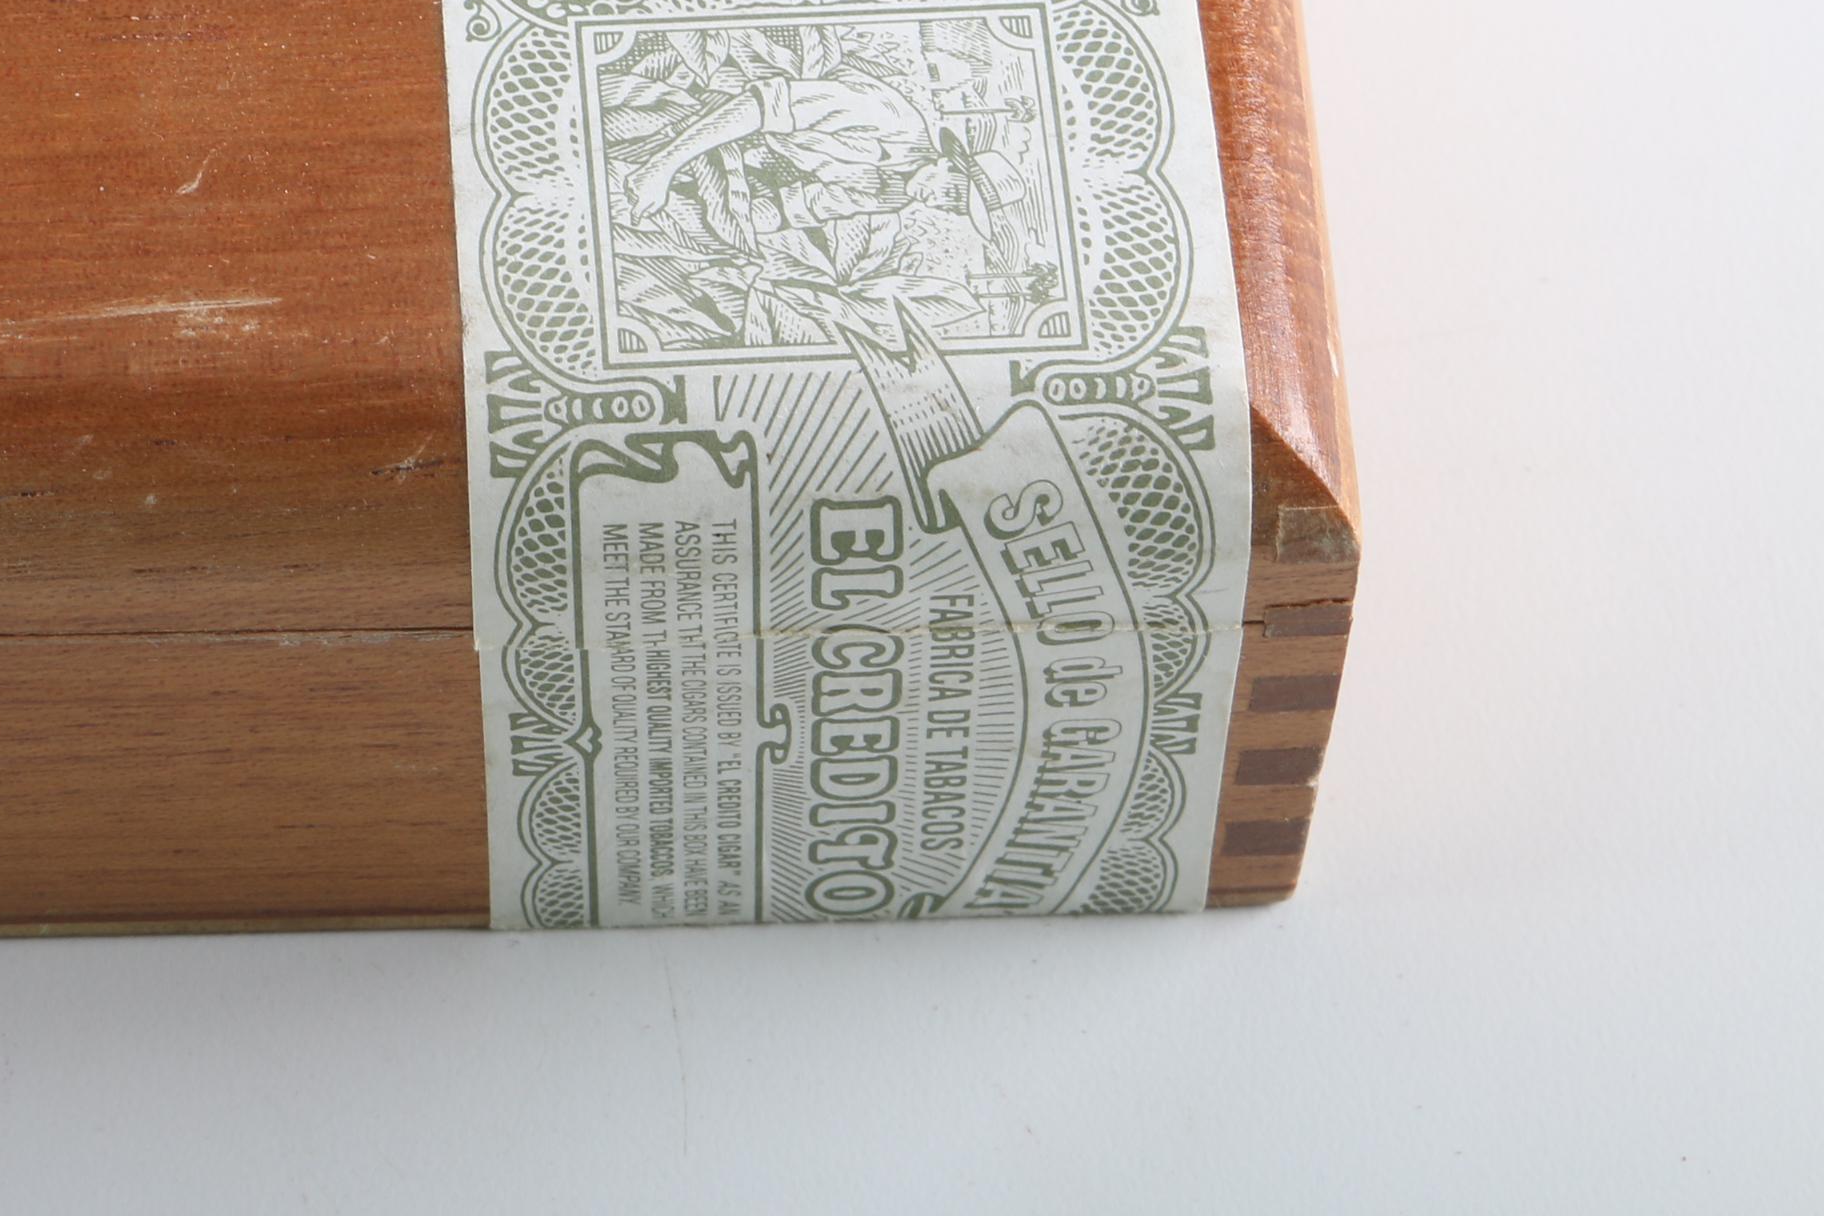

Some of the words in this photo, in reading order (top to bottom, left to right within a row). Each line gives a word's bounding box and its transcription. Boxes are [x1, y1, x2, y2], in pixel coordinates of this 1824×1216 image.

[603, 524, 630, 572] MEET
[639, 522, 666, 574] MADE
[712, 519, 738, 565] THIS
[810, 495, 904, 611] EL
[984, 480, 1115, 646] SELLO
[605, 577, 630, 607] THE
[675, 520, 703, 621] ASSURANCE
[640, 580, 667, 624] FROM
[680, 653, 706, 676] THE
[716, 664, 741, 676] IS
[928, 594, 976, 702] FABRICA
[611, 676, 636, 691] OF
[645, 649, 672, 701] HIGHEST
[1043, 657, 1123, 707] de
[612, 694, 638, 743] QUALITY
[681, 679, 708, 723] CIGARS
[716, 682, 742, 726] ISSUED
[647, 705, 674, 753] QUALITY
[717, 732, 742, 747] BY
[926, 709, 971, 739] DE
[614, 746, 639, 803] REQUIRED
[682, 727, 708, 788] CONTAINED
[804, 625, 904, 916] CREDITO
[648, 758, 674, 815] IMPORTED
[683, 793, 708, 804] IN
[717, 779, 742, 829] CREDITO
[920, 745, 969, 851] TABACOS
[615, 807, 640, 821] BY
[616, 824, 640, 846] OUR
[683, 806, 708, 832] THIS
[964, 719, 1122, 908] GARANTIA
[684, 835, 708, 855] BOX
[717, 834, 742, 876] CIGAR"
[616, 849, 642, 906] COMPANY.
[684, 859, 708, 887] HAVE
[717, 880, 742, 896] AS
[651, 883, 674, 919] WHICH
[684, 889, 708, 917] BEEN
[717, 901, 742, 915] AN
